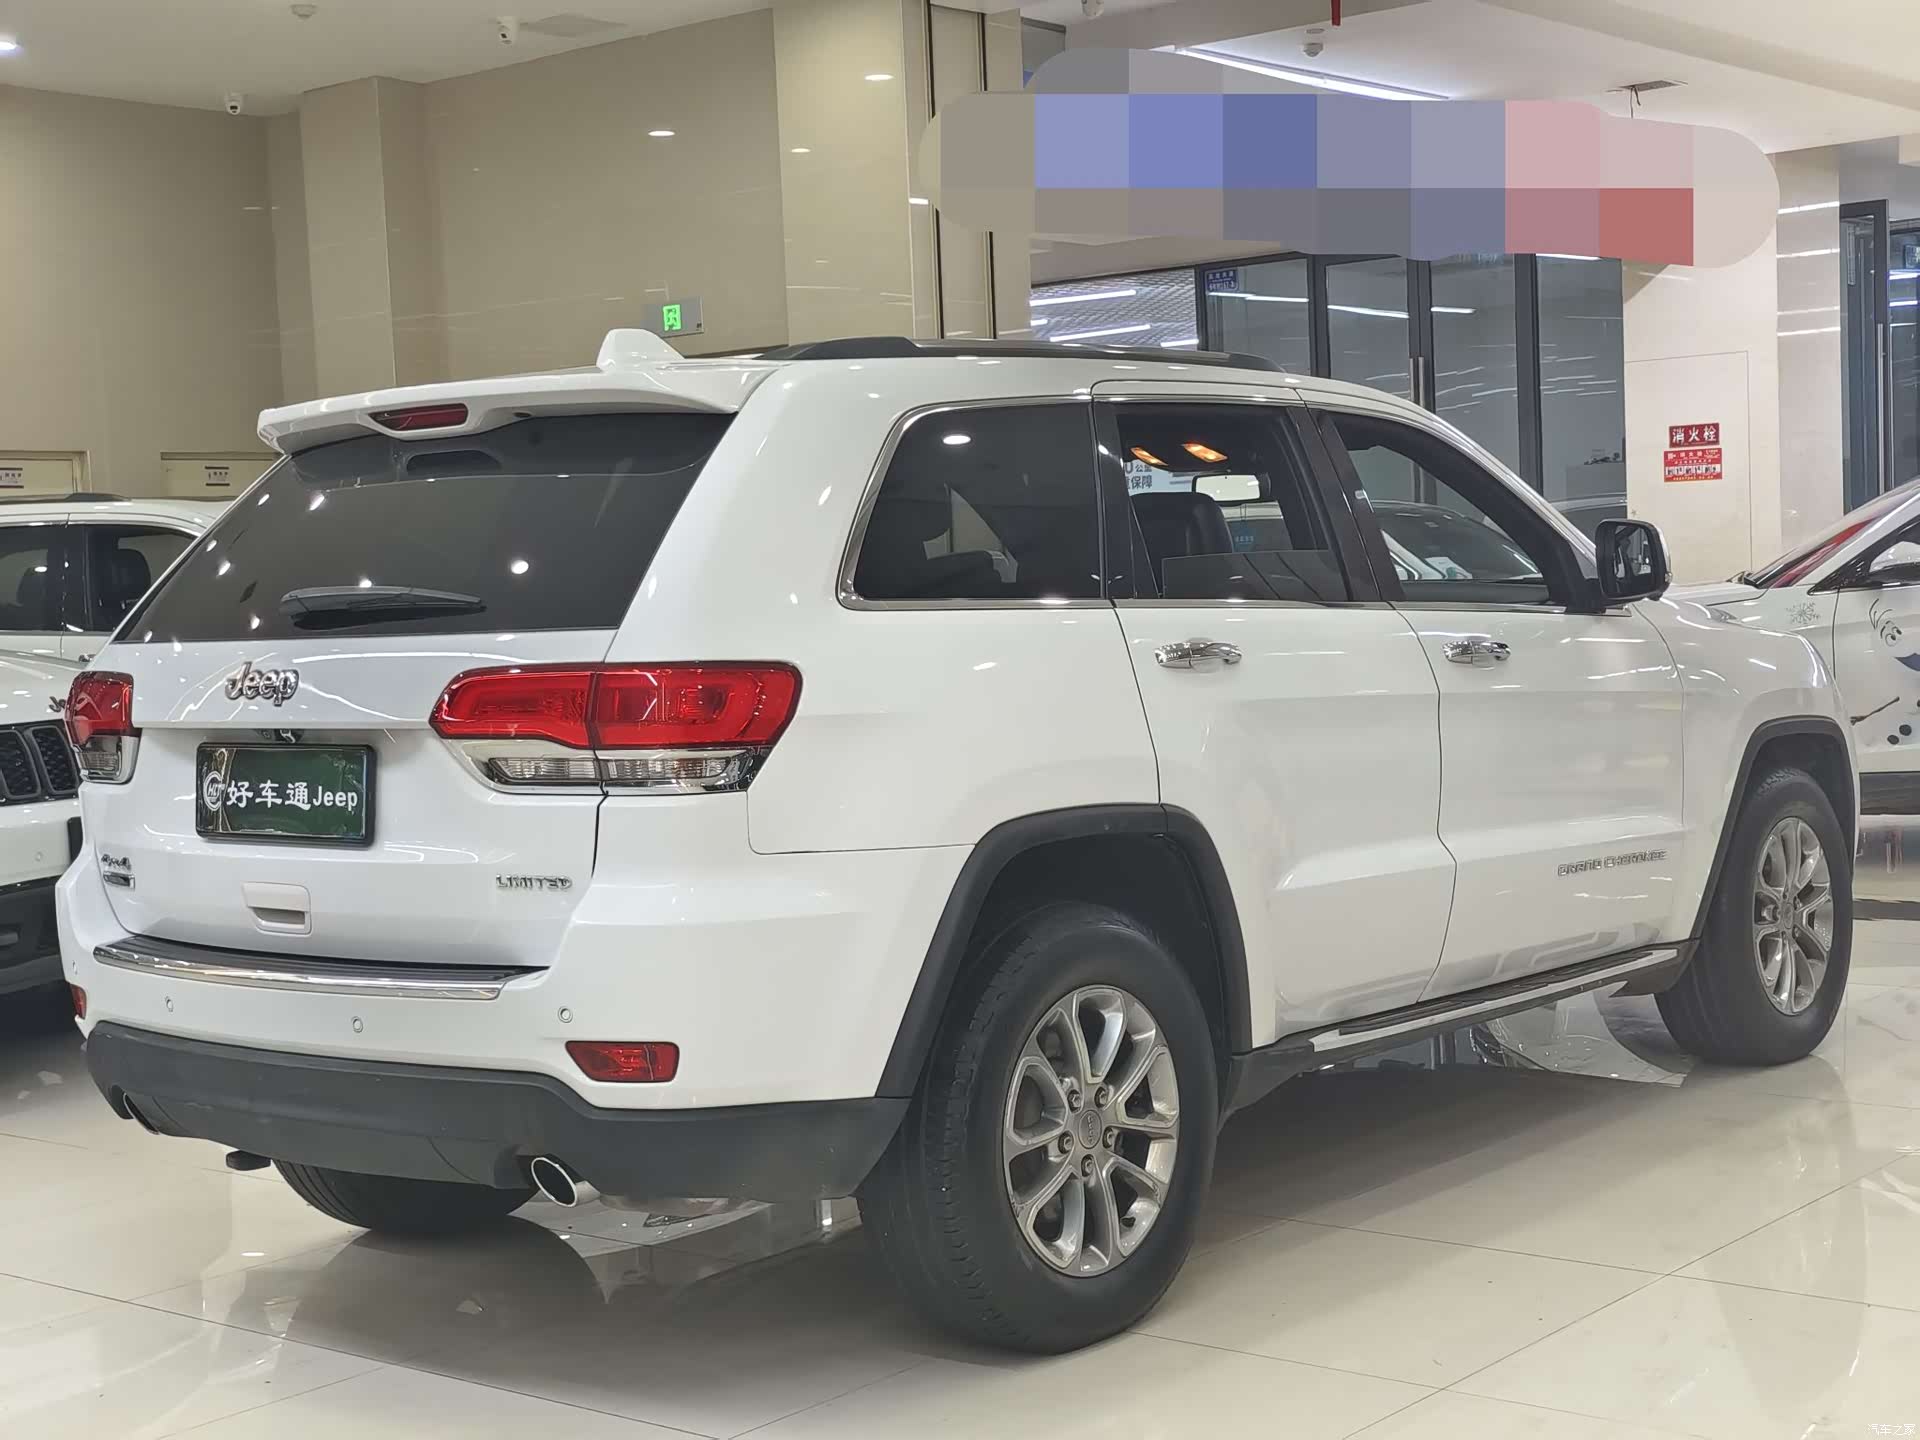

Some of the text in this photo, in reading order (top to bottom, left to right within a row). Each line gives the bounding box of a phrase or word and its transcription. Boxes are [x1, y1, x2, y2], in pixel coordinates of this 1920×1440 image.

[1671, 425, 1717, 444] 消火栓
[225, 661, 299, 707] Jeep
[495, 876, 572, 890] LIMITED
